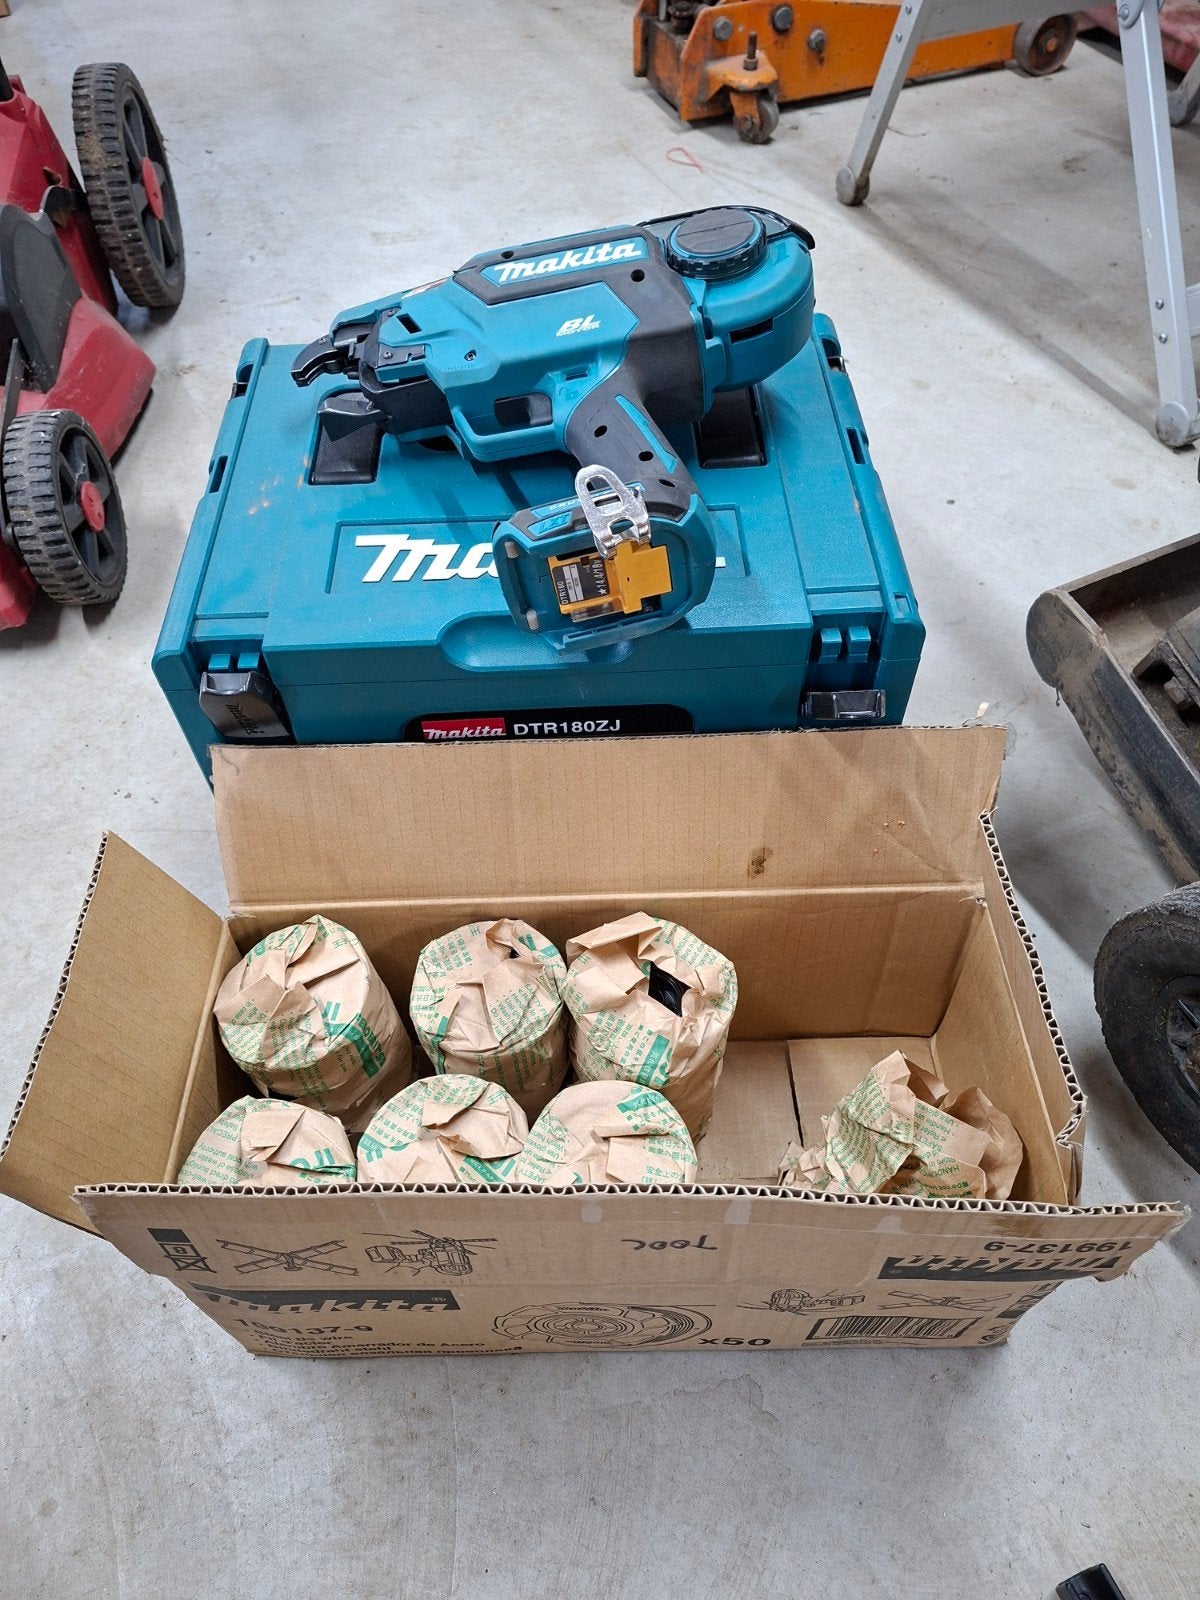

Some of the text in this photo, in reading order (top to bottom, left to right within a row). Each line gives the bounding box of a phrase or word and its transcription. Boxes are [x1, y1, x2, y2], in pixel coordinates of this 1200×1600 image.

[494, 243, 641, 282] makita
[423, 719, 621, 740] makita DTR180ZJ
[983, 1241, 1132, 1254] 199137-9
[698, 1337, 772, 1346] x50
